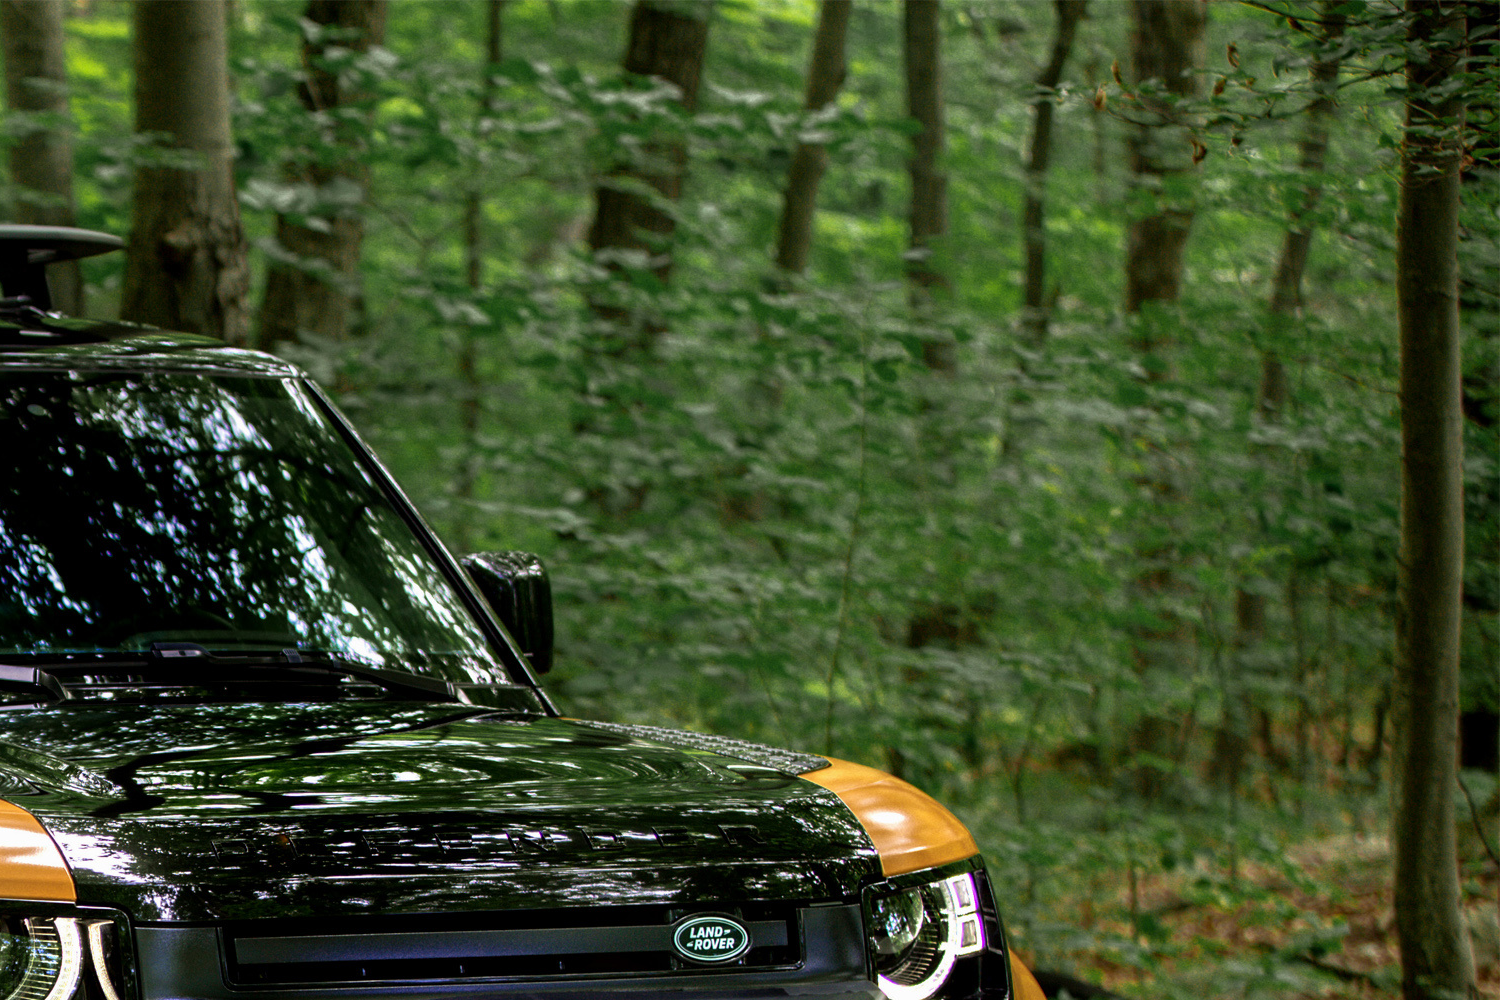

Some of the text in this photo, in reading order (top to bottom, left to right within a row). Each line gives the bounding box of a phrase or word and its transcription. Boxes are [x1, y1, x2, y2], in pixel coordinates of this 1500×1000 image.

[211, 824, 767, 863] DEFENDER
[689, 926, 723, 938] LAND
[693, 937, 735, 950] ROVER
